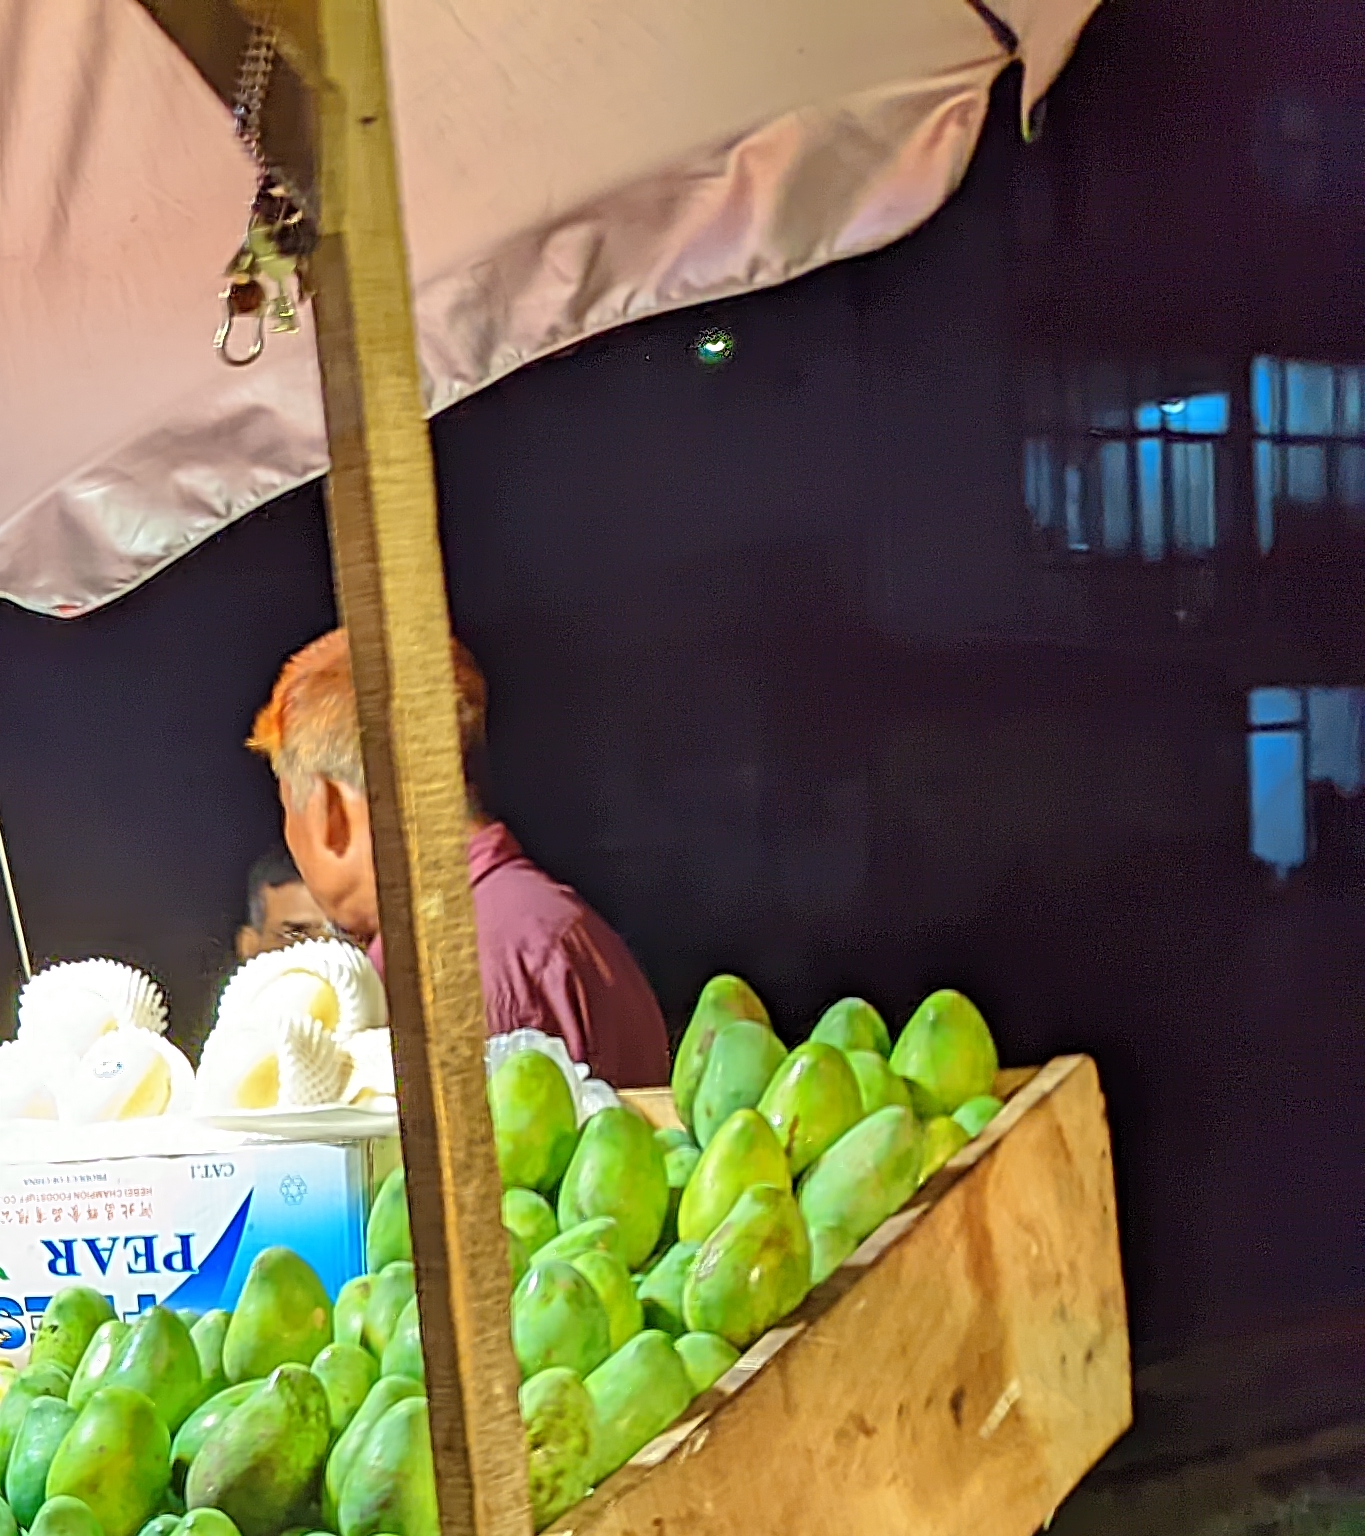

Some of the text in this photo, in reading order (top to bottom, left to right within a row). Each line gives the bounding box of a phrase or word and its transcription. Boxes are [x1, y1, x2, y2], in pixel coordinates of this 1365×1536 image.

[190, 1162, 235, 1179] CAT.1
[73, 1189, 123, 1200] CHAMPION
[40, 1232, 199, 1276] PEAR
